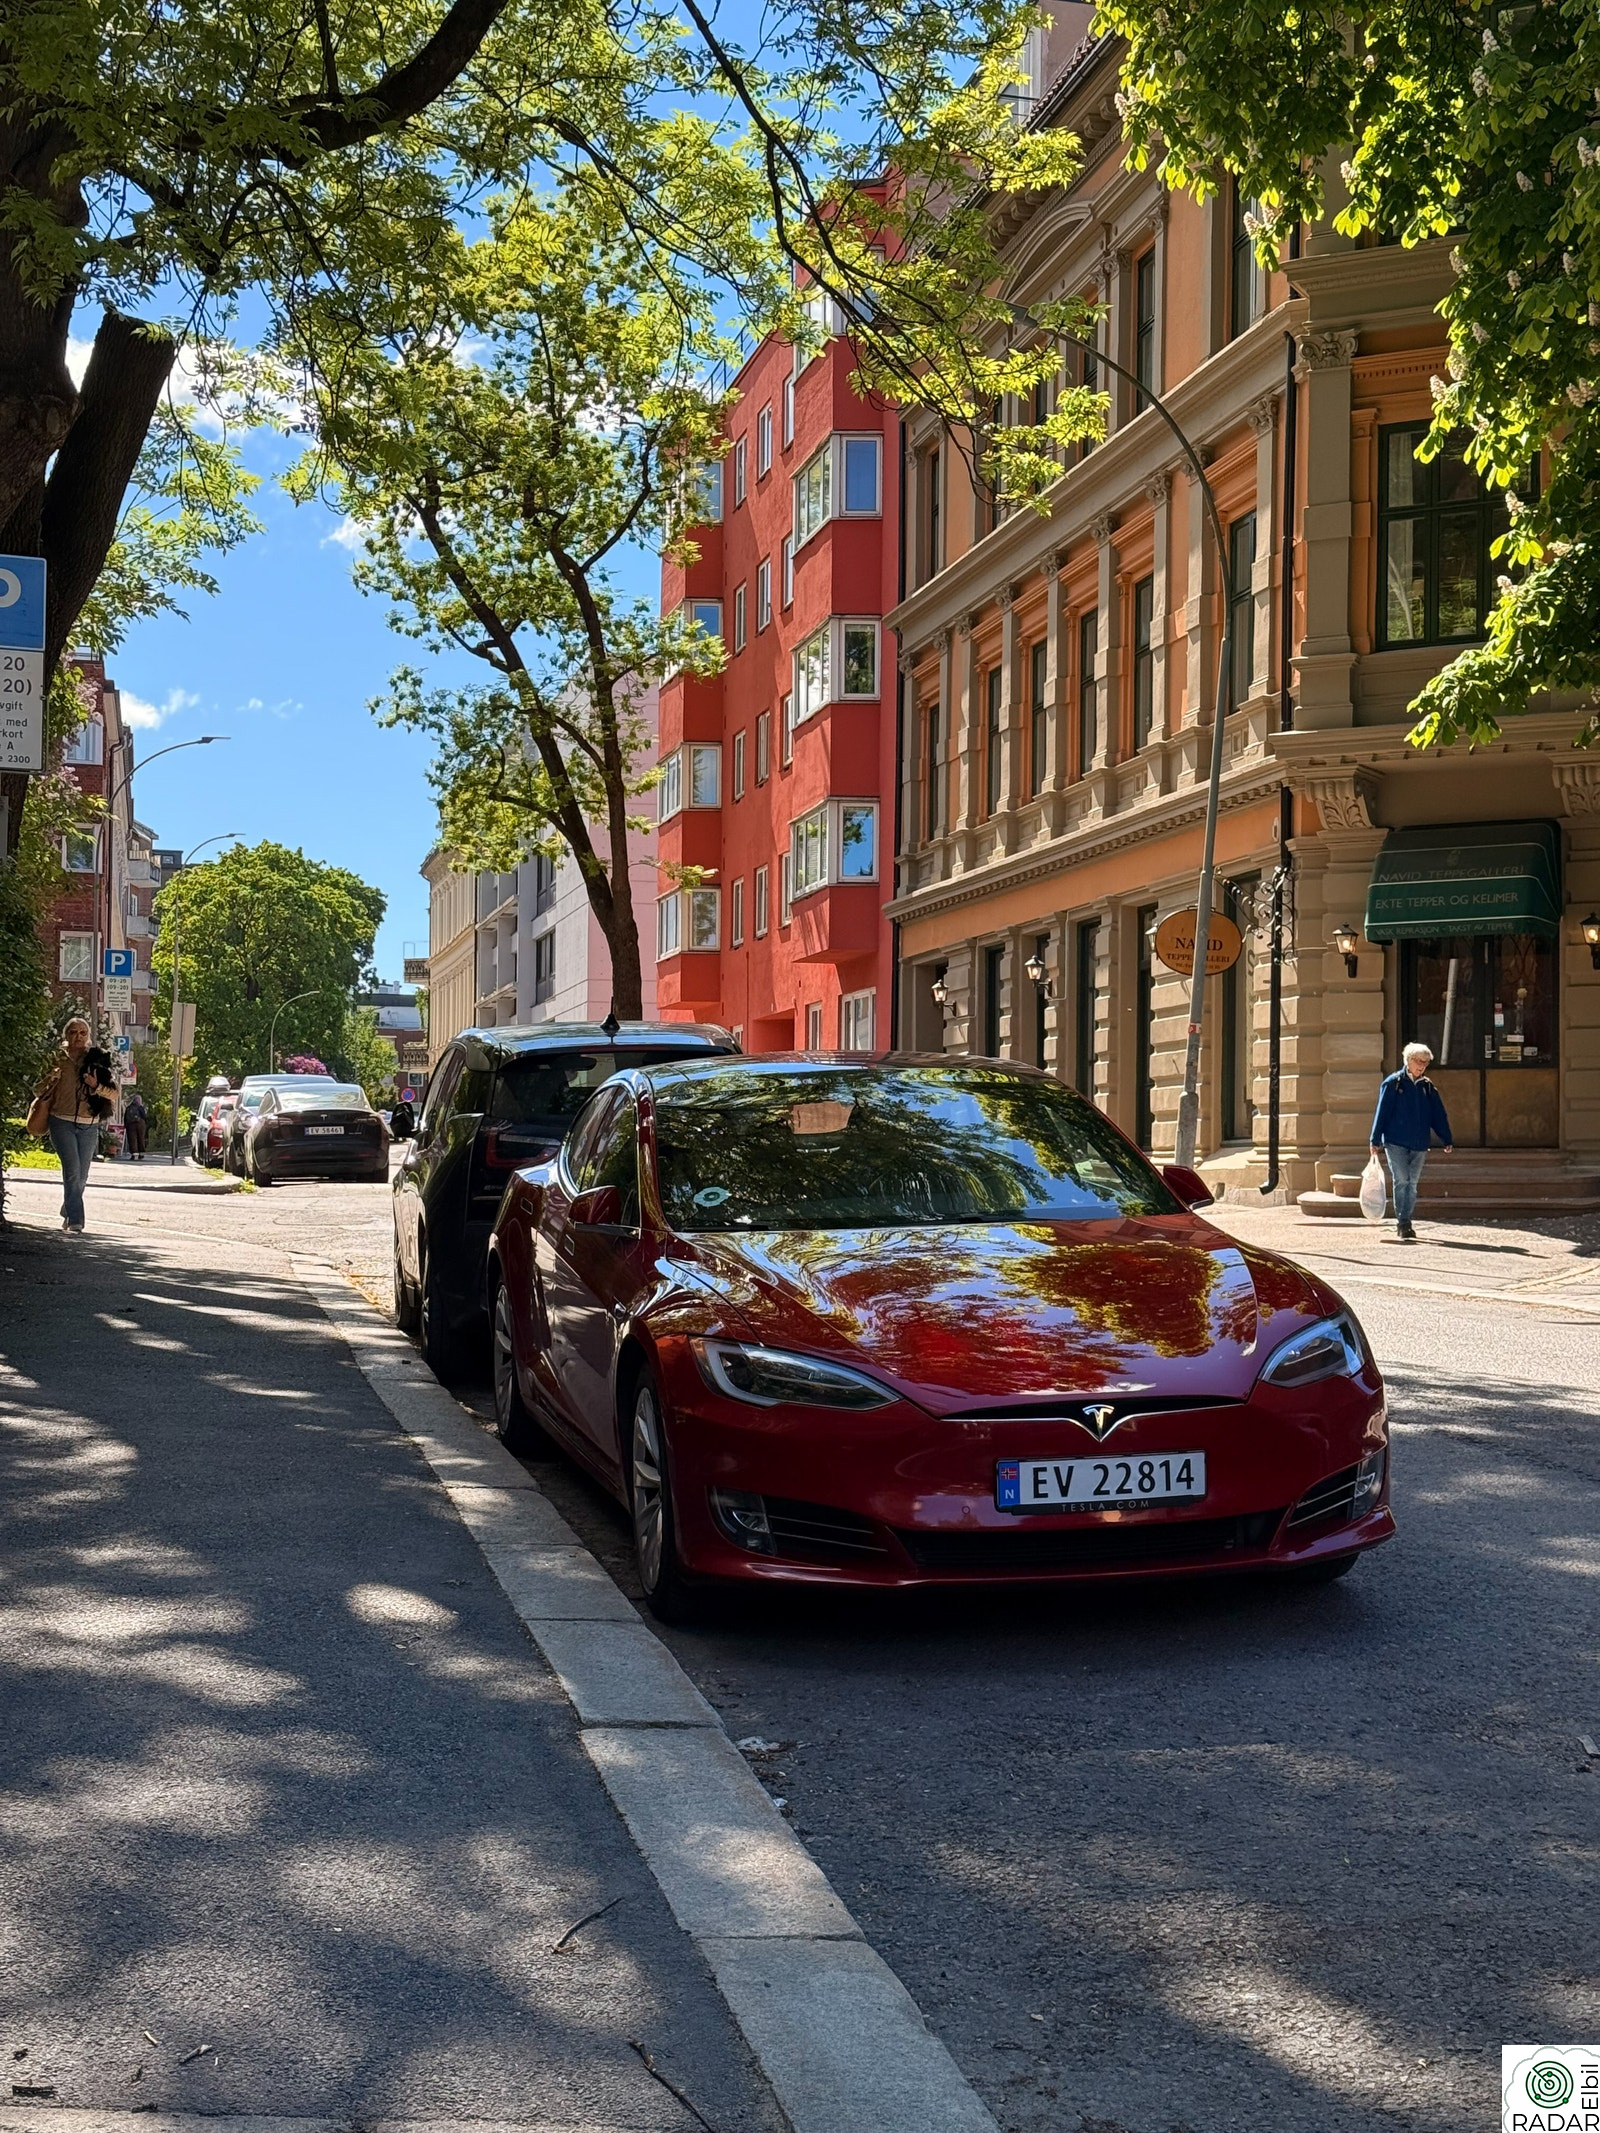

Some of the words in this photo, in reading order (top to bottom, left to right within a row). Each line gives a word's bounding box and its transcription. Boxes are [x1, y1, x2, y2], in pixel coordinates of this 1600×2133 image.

[4, 656, 25, 671] 20
[3, 678, 32, 696] 20)
[6, 718, 28, 727] med
[0, 729, 23, 739] kort
[6, 741, 14, 750] A
[8, 754, 31, 764] 2300
[1378, 871, 1422, 882] NAVID
[1428, 865, 1525, 879] TEPPEGALLERI
[1375, 898, 1403, 909] EKTE
[1406, 896, 1446, 907] TEPPER
[1449, 895, 1469, 905] OG
[1472, 892, 1519, 904] KELIMER
[1175, 937, 1223, 951] NAID
[111, 952, 126, 973] P
[1166, 953, 1230, 963] TEPPELLERI
[117, 1037, 126, 1049] P
[1032, 1465, 1075, 1499] EV
[1093, 1458, 1195, 1496] 22814
[1005, 1489, 1015, 1499] N
[1061, 1500, 1150, 1512] TESLA.COM
